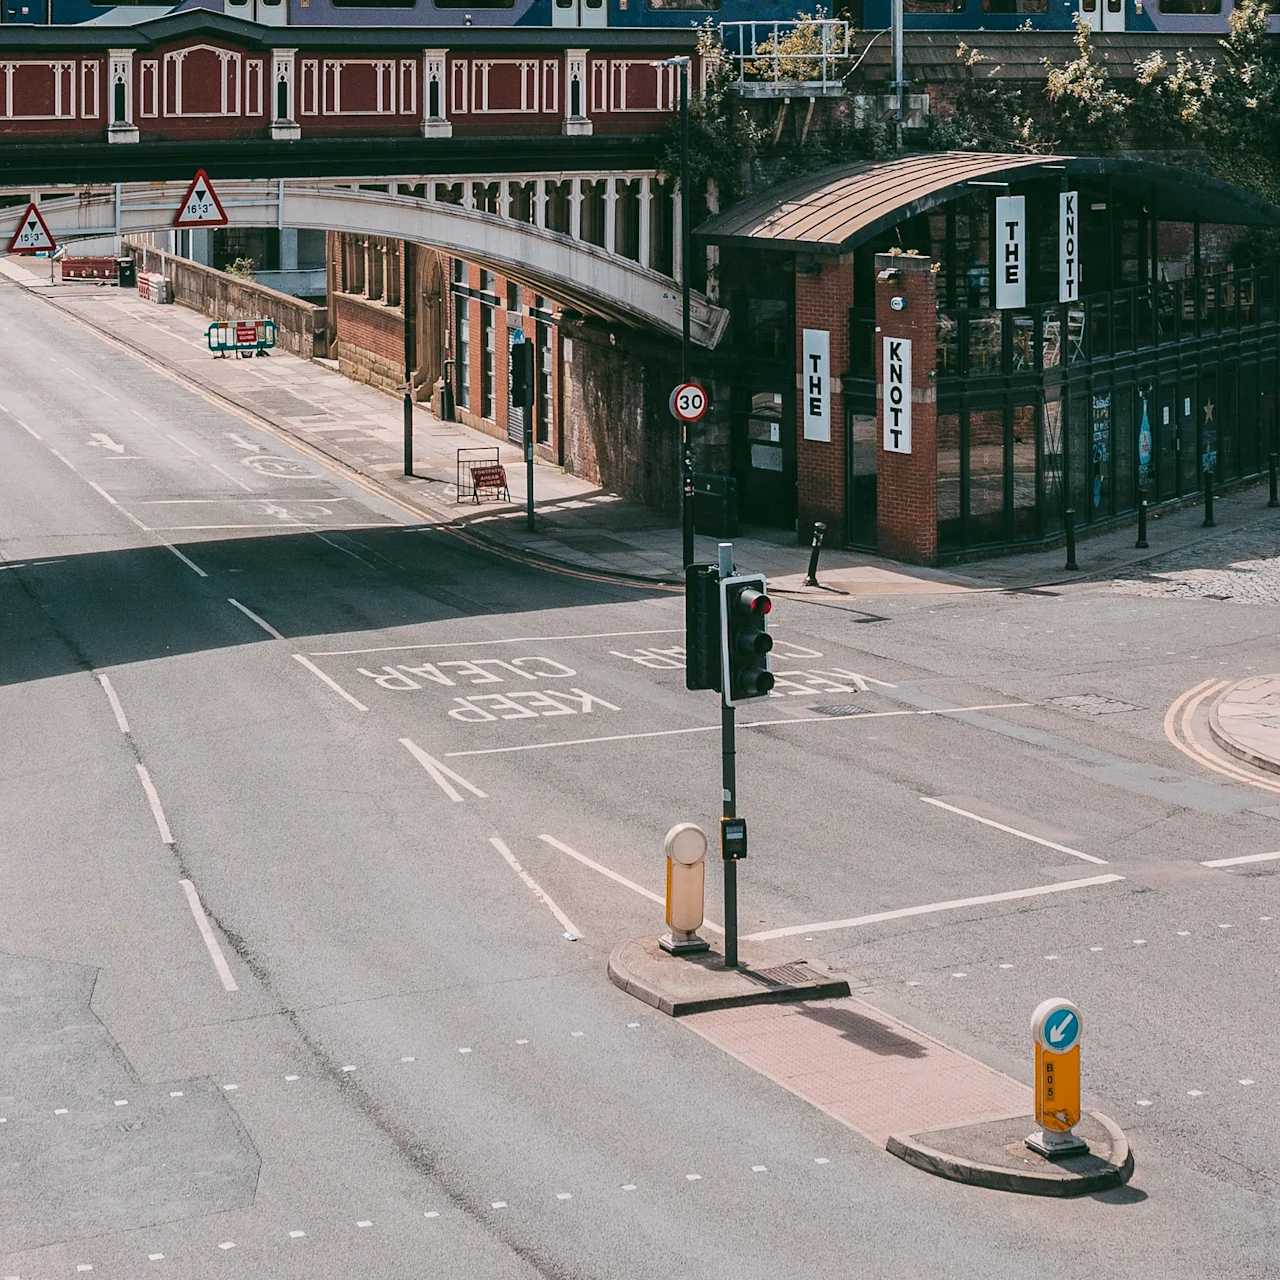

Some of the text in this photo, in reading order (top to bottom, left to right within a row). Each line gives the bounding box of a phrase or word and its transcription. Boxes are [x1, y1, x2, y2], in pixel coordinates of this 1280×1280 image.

[1004, 195, 1075, 298] THE KNOTT
[679, 394, 703, 411] 30
[808, 341, 903, 449] THE KNOTT
[356, 656, 577, 691] CLEAR
[447, 688, 622, 722] KEEP
